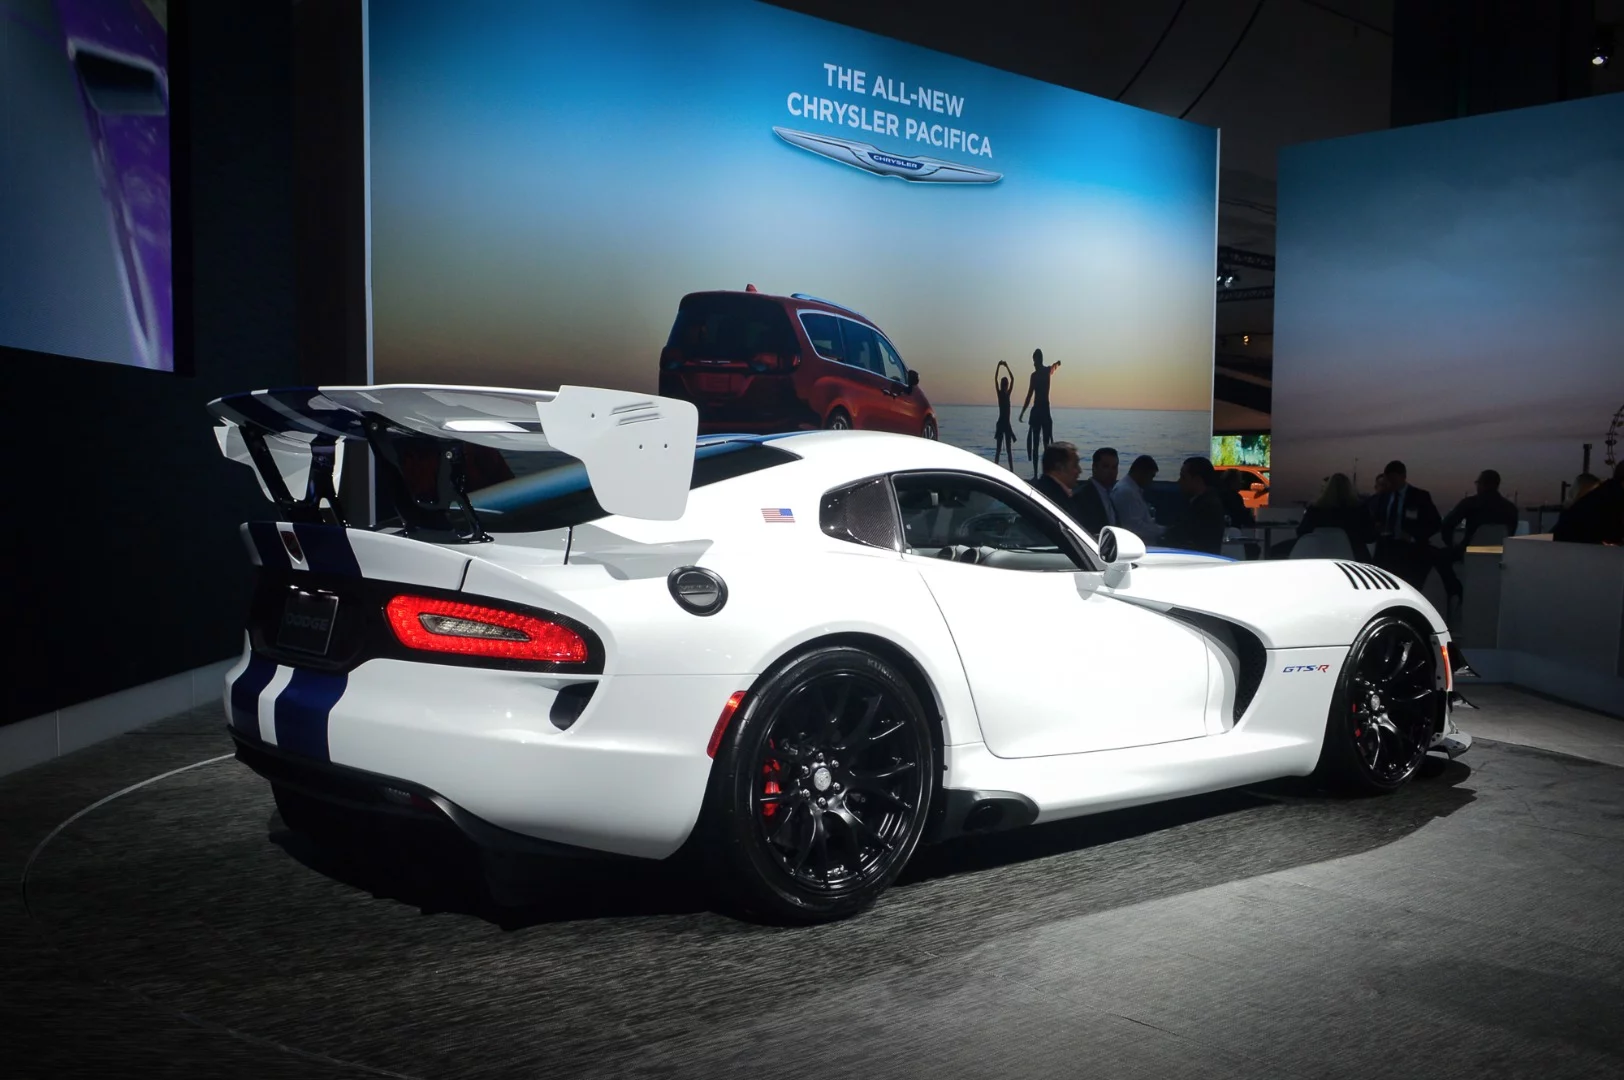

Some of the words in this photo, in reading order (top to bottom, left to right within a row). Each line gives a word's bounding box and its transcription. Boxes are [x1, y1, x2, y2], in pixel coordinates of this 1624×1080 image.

[823, 62, 866, 95] THE
[871, 75, 965, 118] ALL-NEW
[786, 91, 900, 137] CHRYSLER
[905, 117, 993, 158] PACIFICA
[872, 154, 918, 169] CHRYSLER
[285, 612, 330, 632] DODGE
